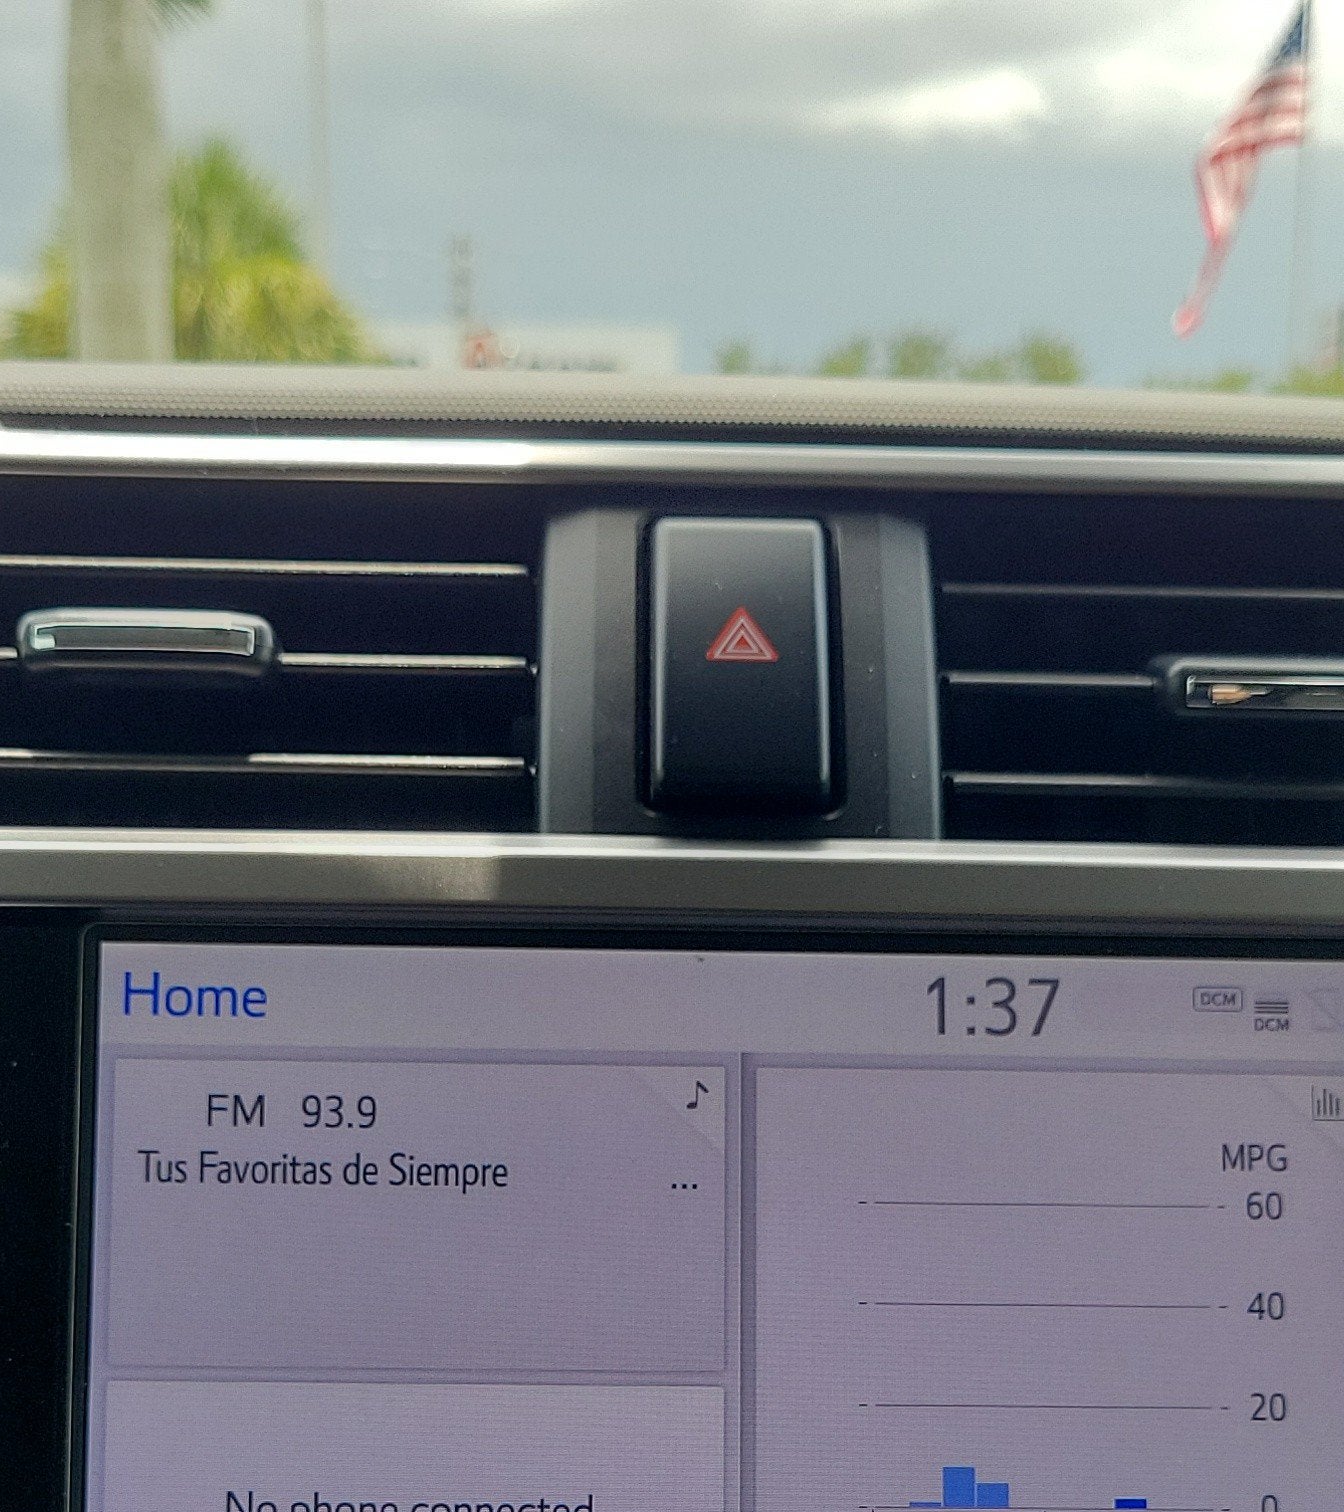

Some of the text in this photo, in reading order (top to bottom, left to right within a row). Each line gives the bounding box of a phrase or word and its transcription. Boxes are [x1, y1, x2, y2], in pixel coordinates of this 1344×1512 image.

[123, 971, 267, 1017] Home
[926, 976, 1060, 1037] 1:37
[1200, 992, 1236, 1007] DCM
[1254, 1018, 1290, 1032] DCM
[207, 1095, 377, 1128] FM 93.9
[138, 1150, 509, 1194] Tus Favoritas de Siempre
[1221, 1144, 1288, 1172] MPG
[1245, 1192, 1283, 1221] 60
[1246, 1292, 1284, 1321] 40
[1250, 1393, 1286, 1422] 20
